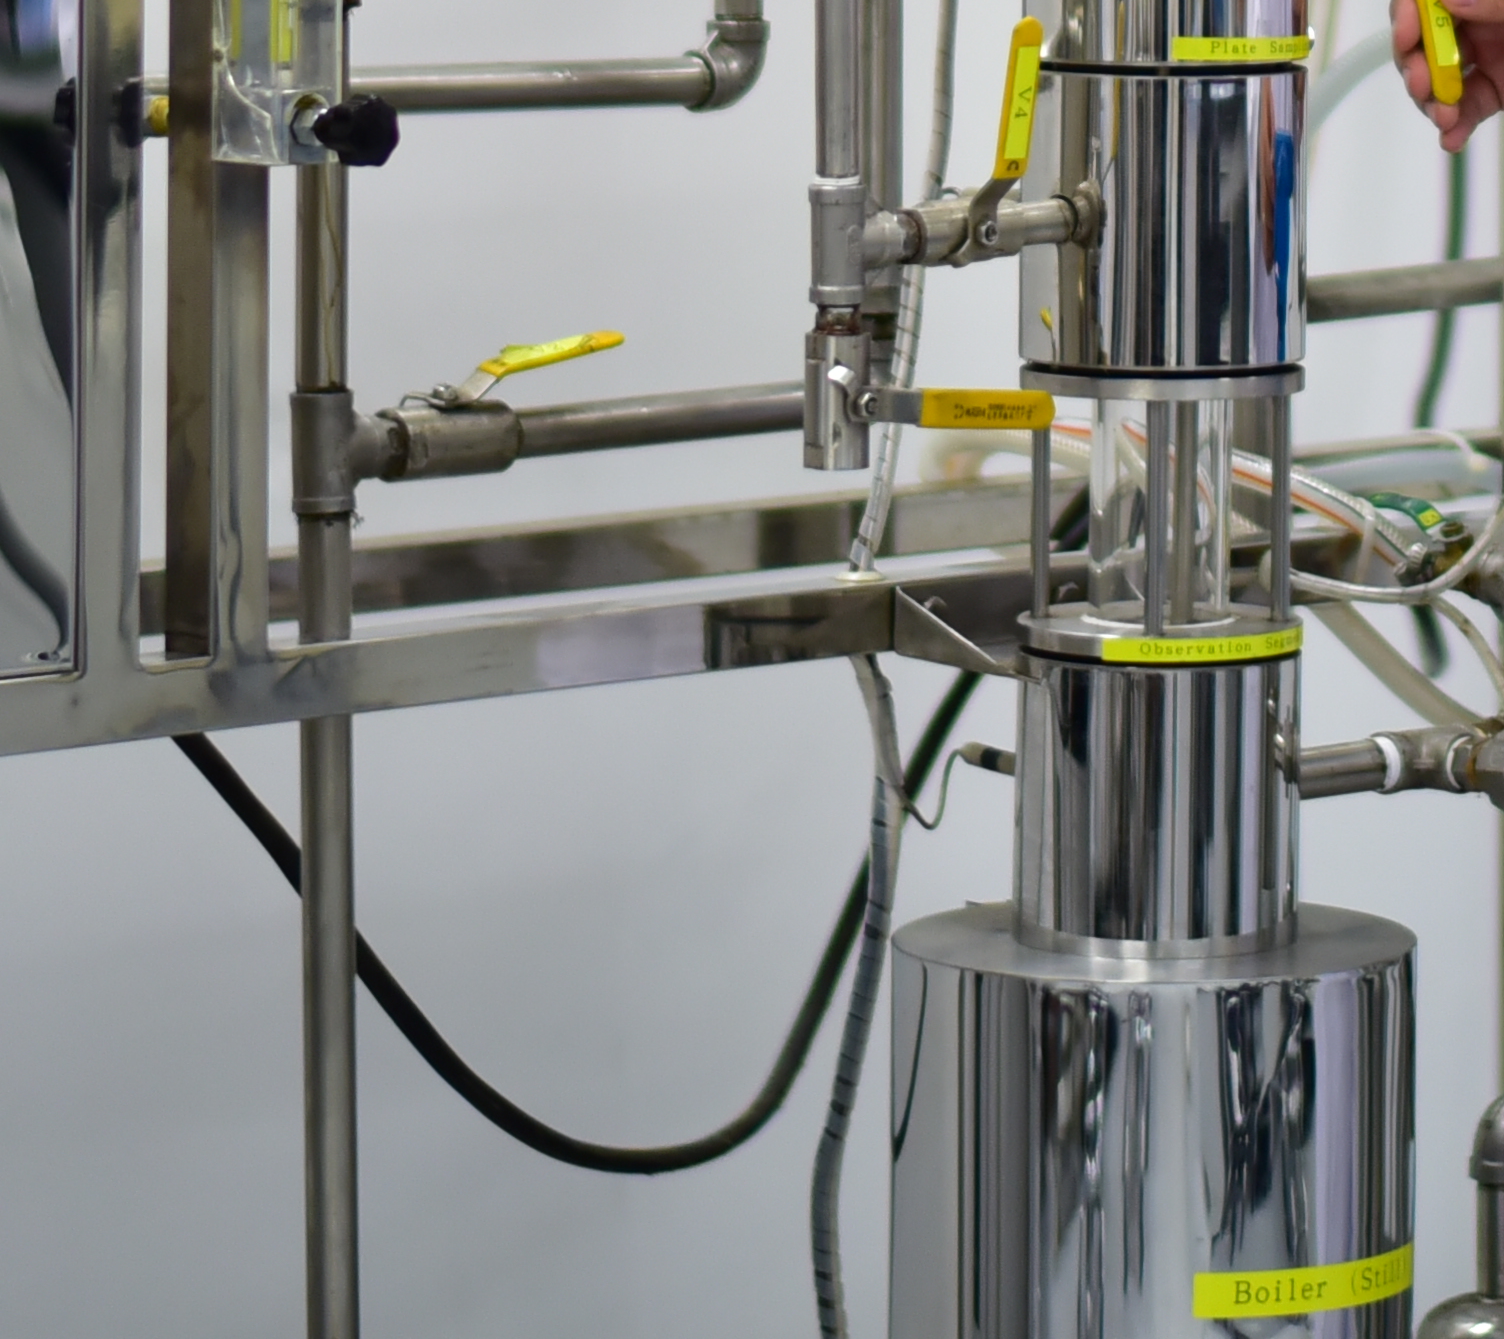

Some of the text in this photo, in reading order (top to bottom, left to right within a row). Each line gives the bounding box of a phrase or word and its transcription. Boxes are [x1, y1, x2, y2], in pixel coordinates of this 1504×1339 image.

[1210, 40, 1256, 54] Plate
[1014, 86, 1033, 119] V4
[1139, 640, 1252, 656] Observation
[1233, 1277, 1328, 1306] Boiler
